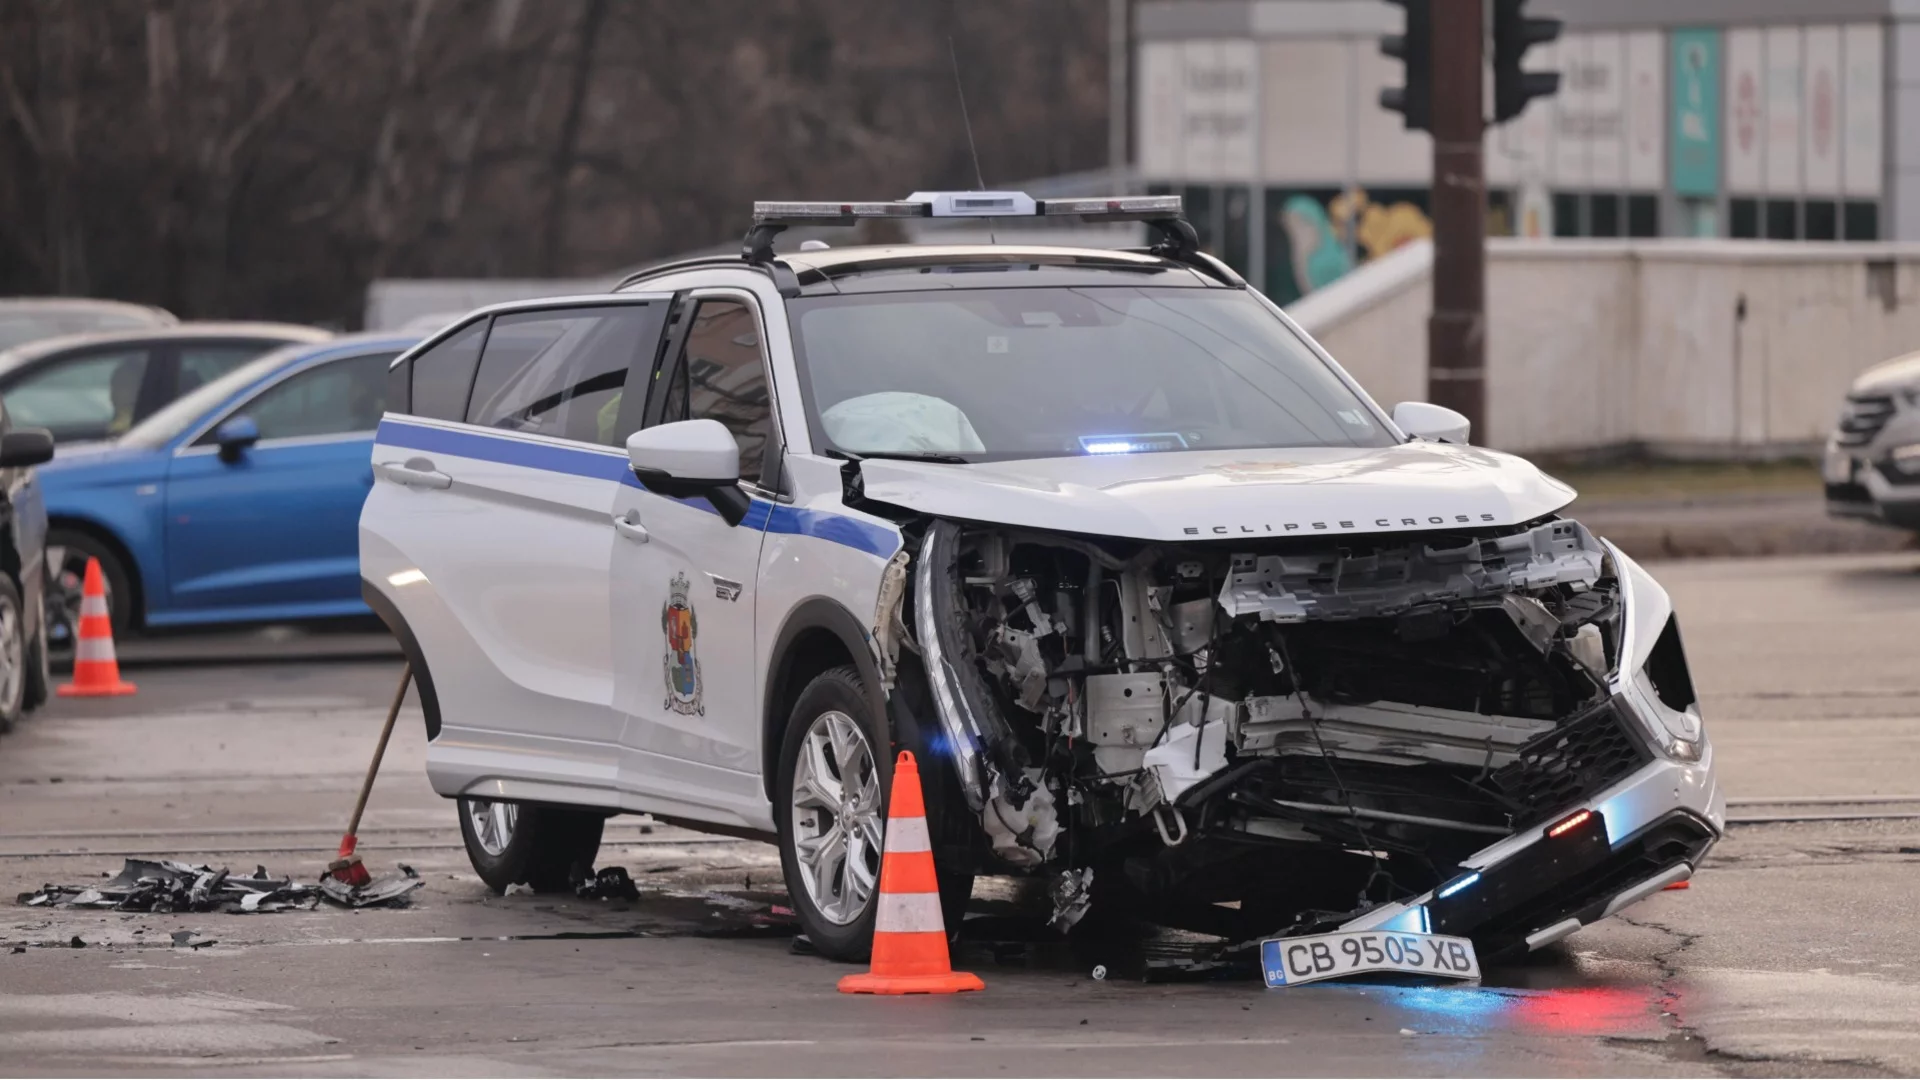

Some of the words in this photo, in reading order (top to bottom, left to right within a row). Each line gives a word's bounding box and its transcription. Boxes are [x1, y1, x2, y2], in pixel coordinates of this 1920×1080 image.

[1183, 520, 1355, 535] ECLIPSE
[1375, 513, 1495, 527] CROSS
[1287, 942, 1336, 977] CB
[1341, 936, 1425, 968] 9505
[1427, 939, 1471, 972] XB
[1268, 970, 1284, 981] BG
